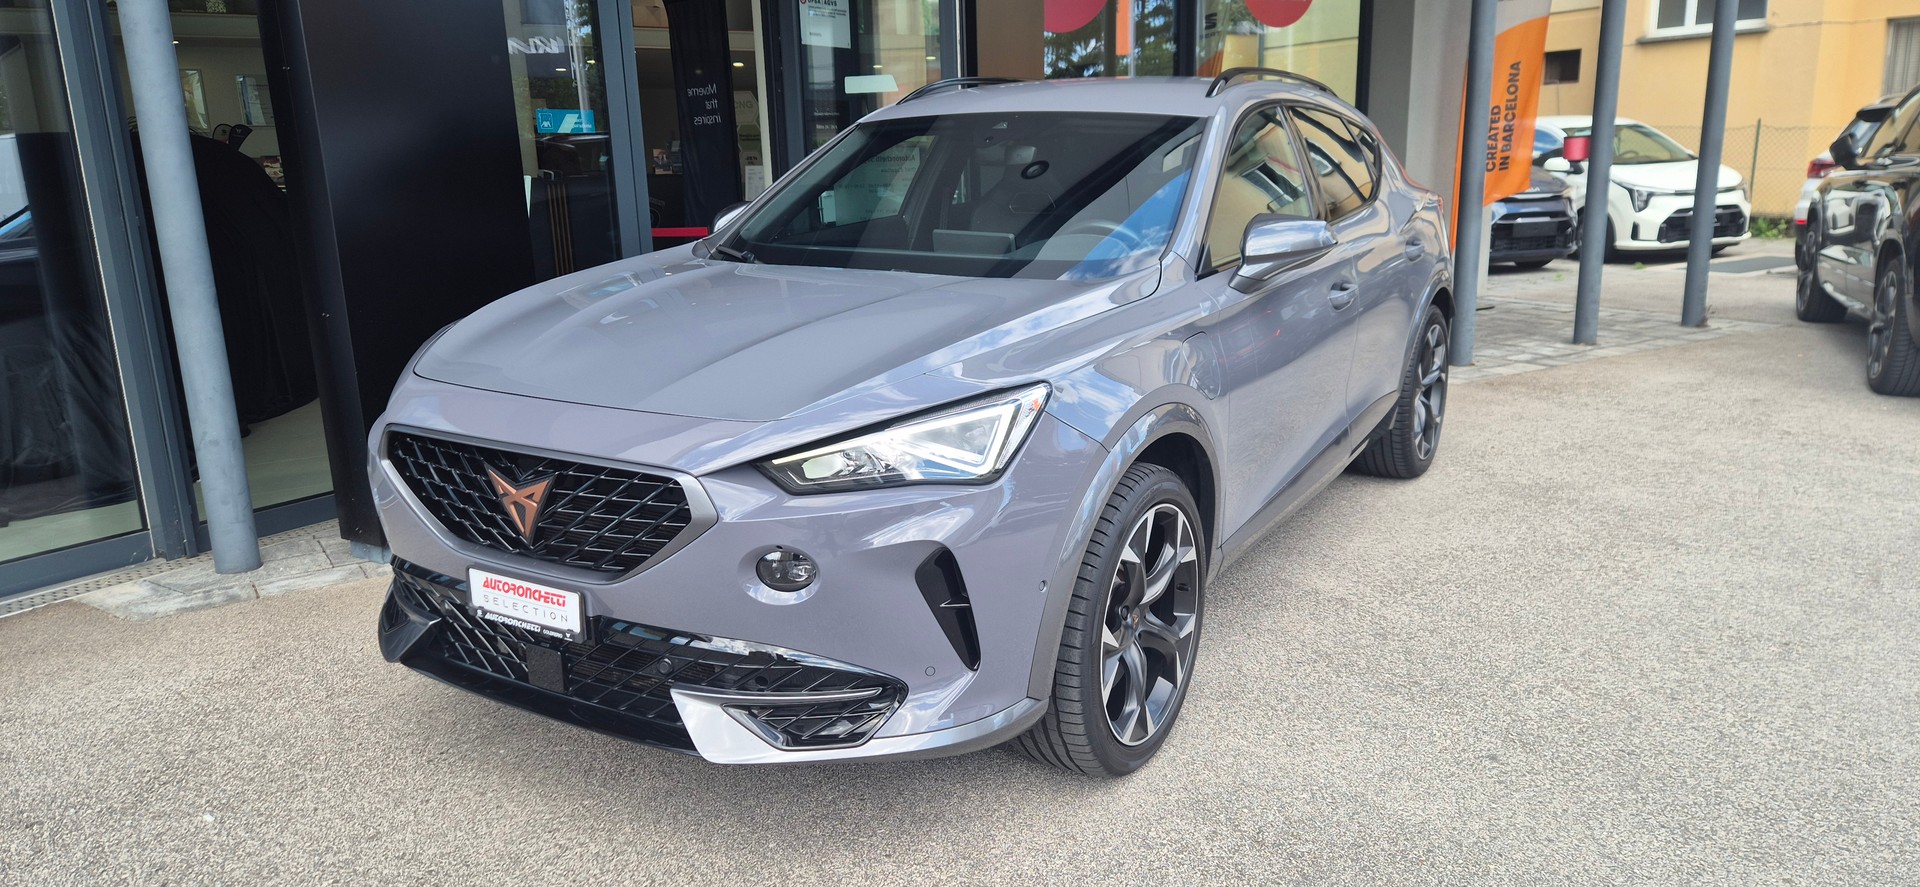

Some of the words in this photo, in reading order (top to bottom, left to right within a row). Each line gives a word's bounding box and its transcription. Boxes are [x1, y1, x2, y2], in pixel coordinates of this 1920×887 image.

[1501, 61, 1521, 152] BARCELONA
[1486, 105, 1501, 172] CREATED
[1499, 156, 1510, 171] IN
[483, 577, 566, 607] AUTORONCHETTI
[483, 594, 568, 623] SELECTION
[485, 612, 541, 633] AUTORONCHETTI
